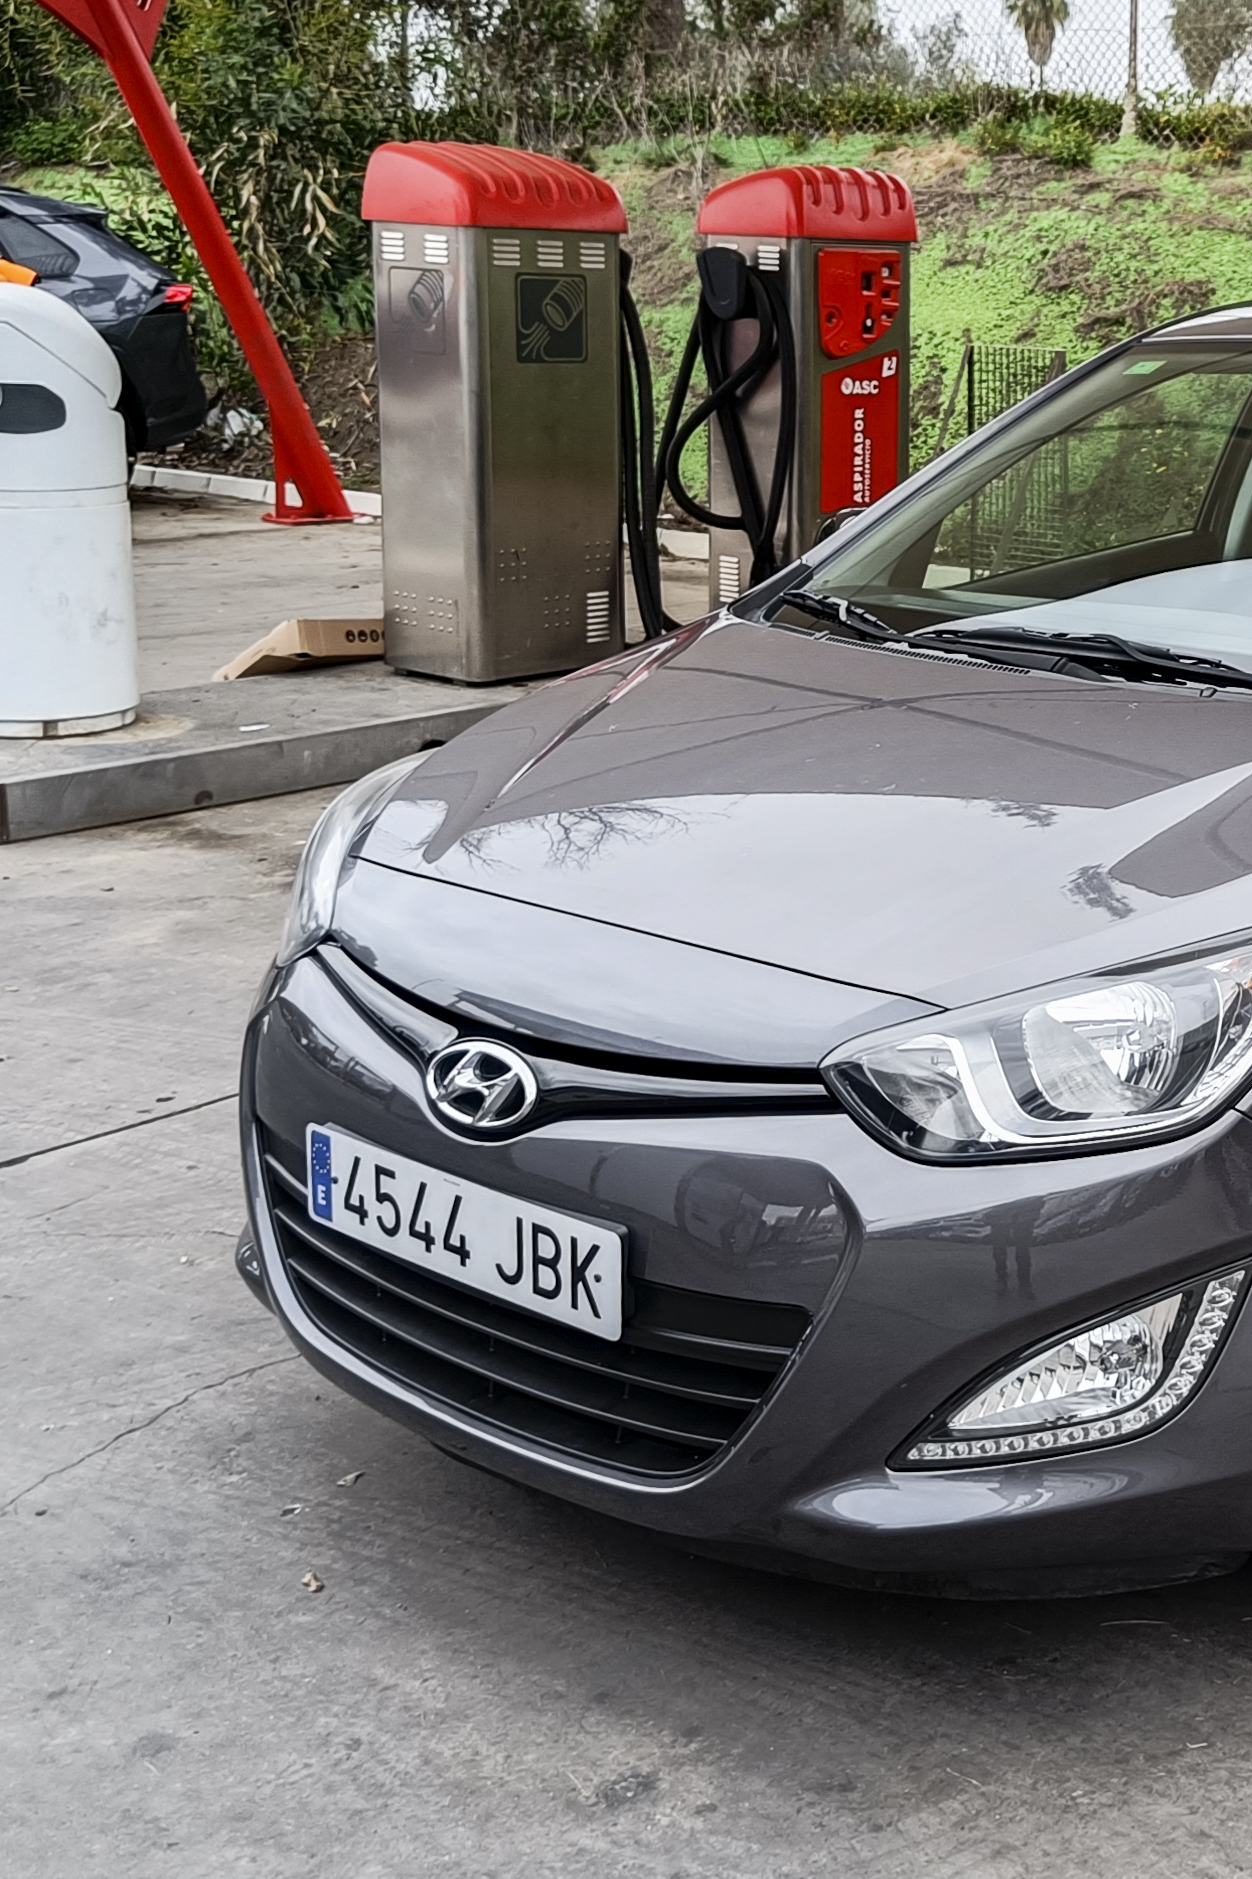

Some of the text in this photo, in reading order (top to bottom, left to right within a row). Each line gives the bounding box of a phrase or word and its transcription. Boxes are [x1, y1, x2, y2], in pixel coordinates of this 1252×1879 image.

[853, 380, 879, 394] ASC
[853, 408, 865, 503] ASPIRADOR
[864, 438, 872, 503] AUTOSERVICIO
[317, 1184, 327, 1206] E
[343, 1156, 602, 1320] 4544 JBK
